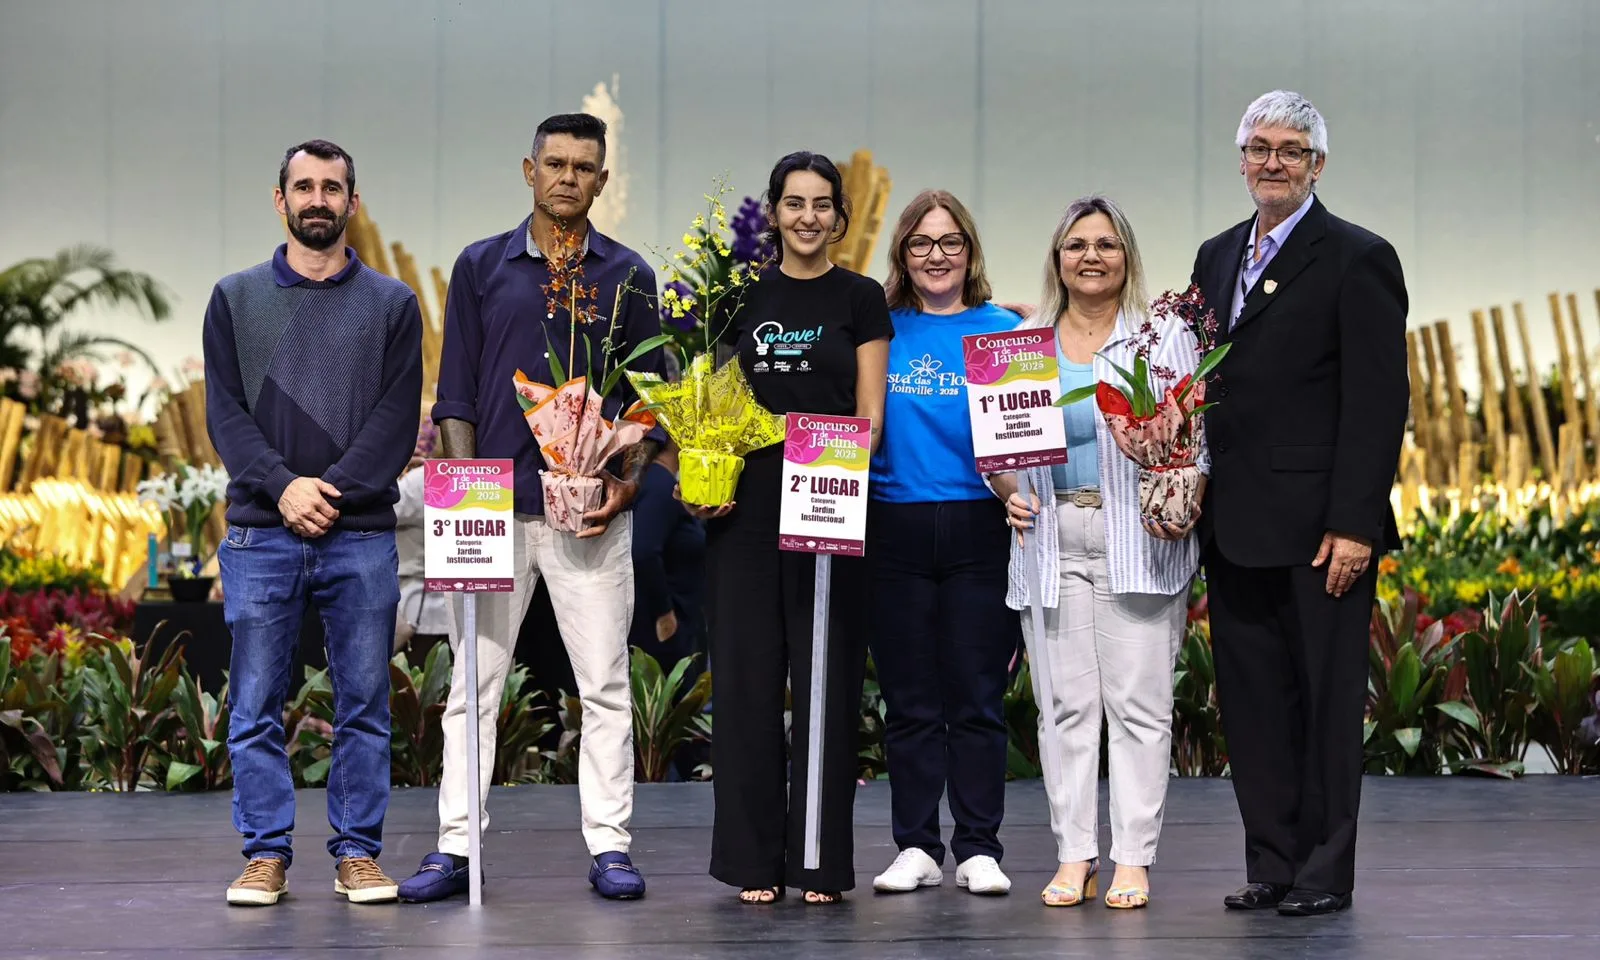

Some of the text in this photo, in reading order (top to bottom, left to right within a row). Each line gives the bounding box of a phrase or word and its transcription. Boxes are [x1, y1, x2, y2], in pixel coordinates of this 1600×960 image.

[975, 335, 1042, 350] Concurso
[1001, 347, 1011, 355] de
[992, 347, 1044, 367] Jardins
[1020, 361, 1044, 371] 2025
[914, 377, 931, 385] das
[890, 383, 933, 395] Joinville
[998, 389, 1052, 412] LUGAR
[798, 416, 858, 433] Concurso
[1006, 421, 1031, 430] Jardim
[819, 430, 829, 438] de
[995, 428, 1043, 440] Institucional
[808, 432, 858, 449] Jardins
[834, 449, 857, 459] 2025
[437, 462, 500, 475] Concurso
[460, 474, 470, 482] de
[450, 476, 501, 493] Jardins
[810, 476, 860, 497] LUGAR
[477, 491, 500, 500] 2025
[812, 505, 835, 514] Jardim
[801, 513, 845, 524] Institucional
[455, 519, 506, 537] LUGAR
[446, 556, 493, 564] Institucional
